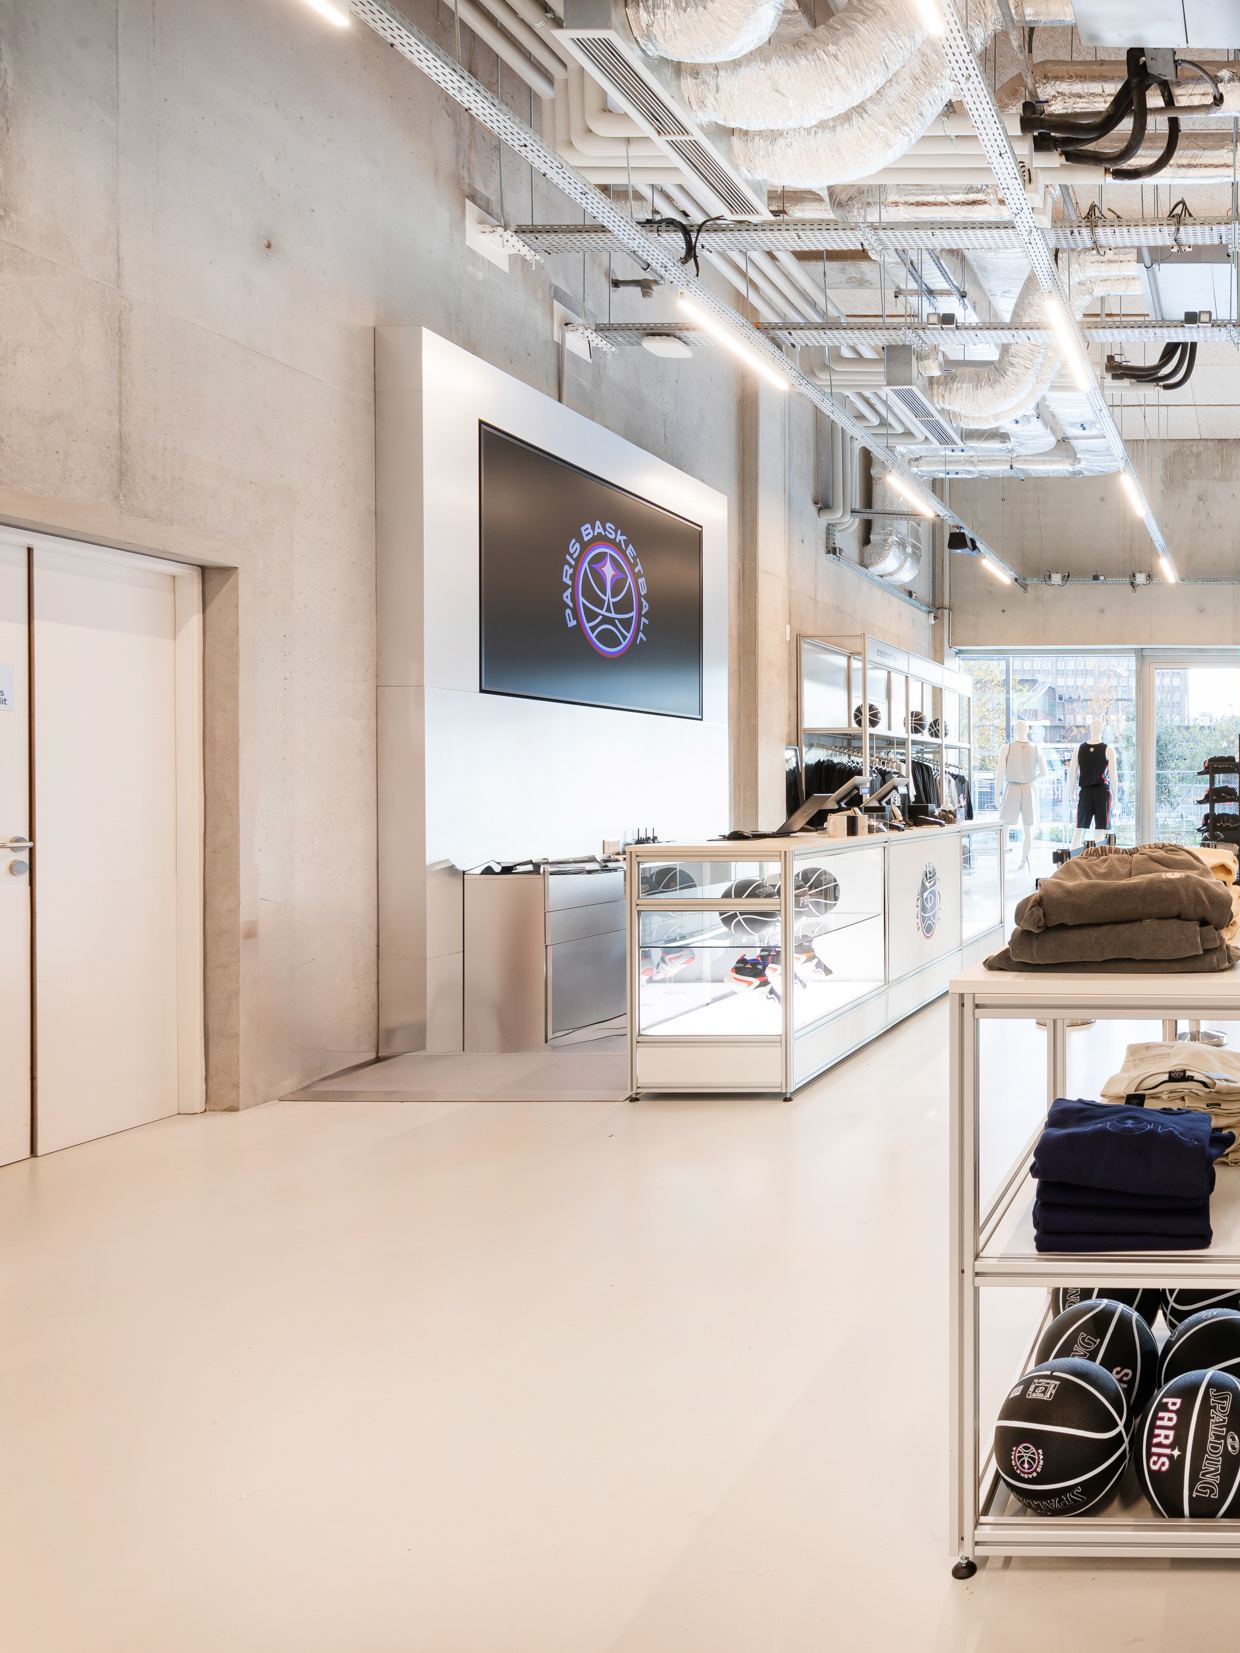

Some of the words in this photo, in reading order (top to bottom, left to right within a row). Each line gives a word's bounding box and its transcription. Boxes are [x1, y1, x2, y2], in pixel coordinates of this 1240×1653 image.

[562, 537, 581, 628] PARIS
[580, 520, 649, 645] BASKETBALL
[1149, 1397, 1183, 1472] PARIS
[1192, 1388, 1233, 1499] SPALDING
